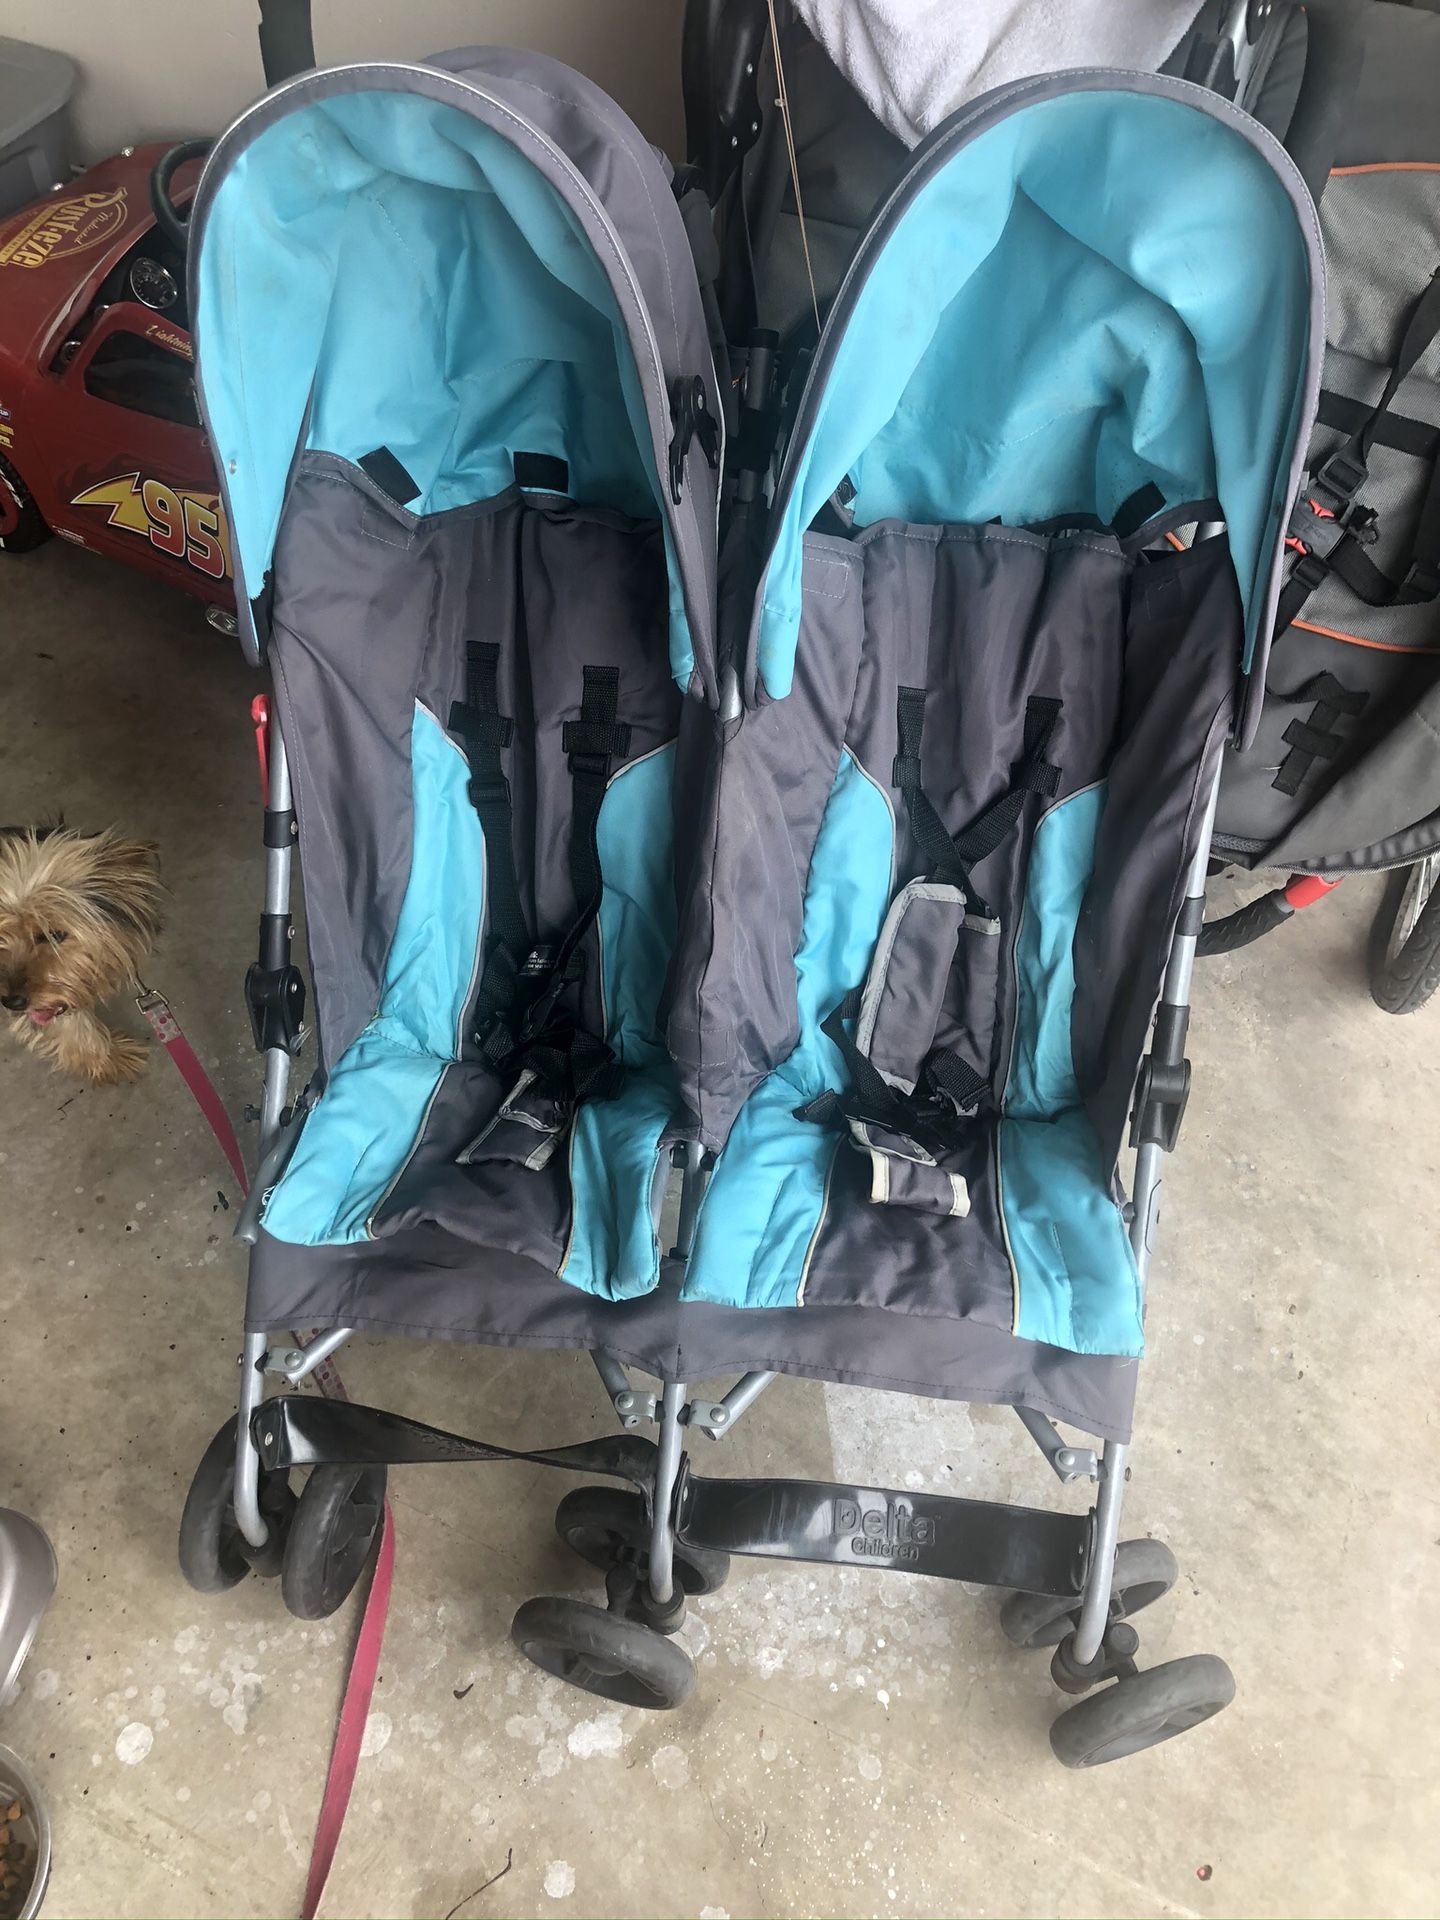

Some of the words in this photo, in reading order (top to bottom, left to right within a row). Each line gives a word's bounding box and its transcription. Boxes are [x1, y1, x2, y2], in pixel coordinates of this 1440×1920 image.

[142, 479, 225, 579] 95
[833, 1498, 936, 1546] Delta
[851, 1536, 920, 1561] Children
